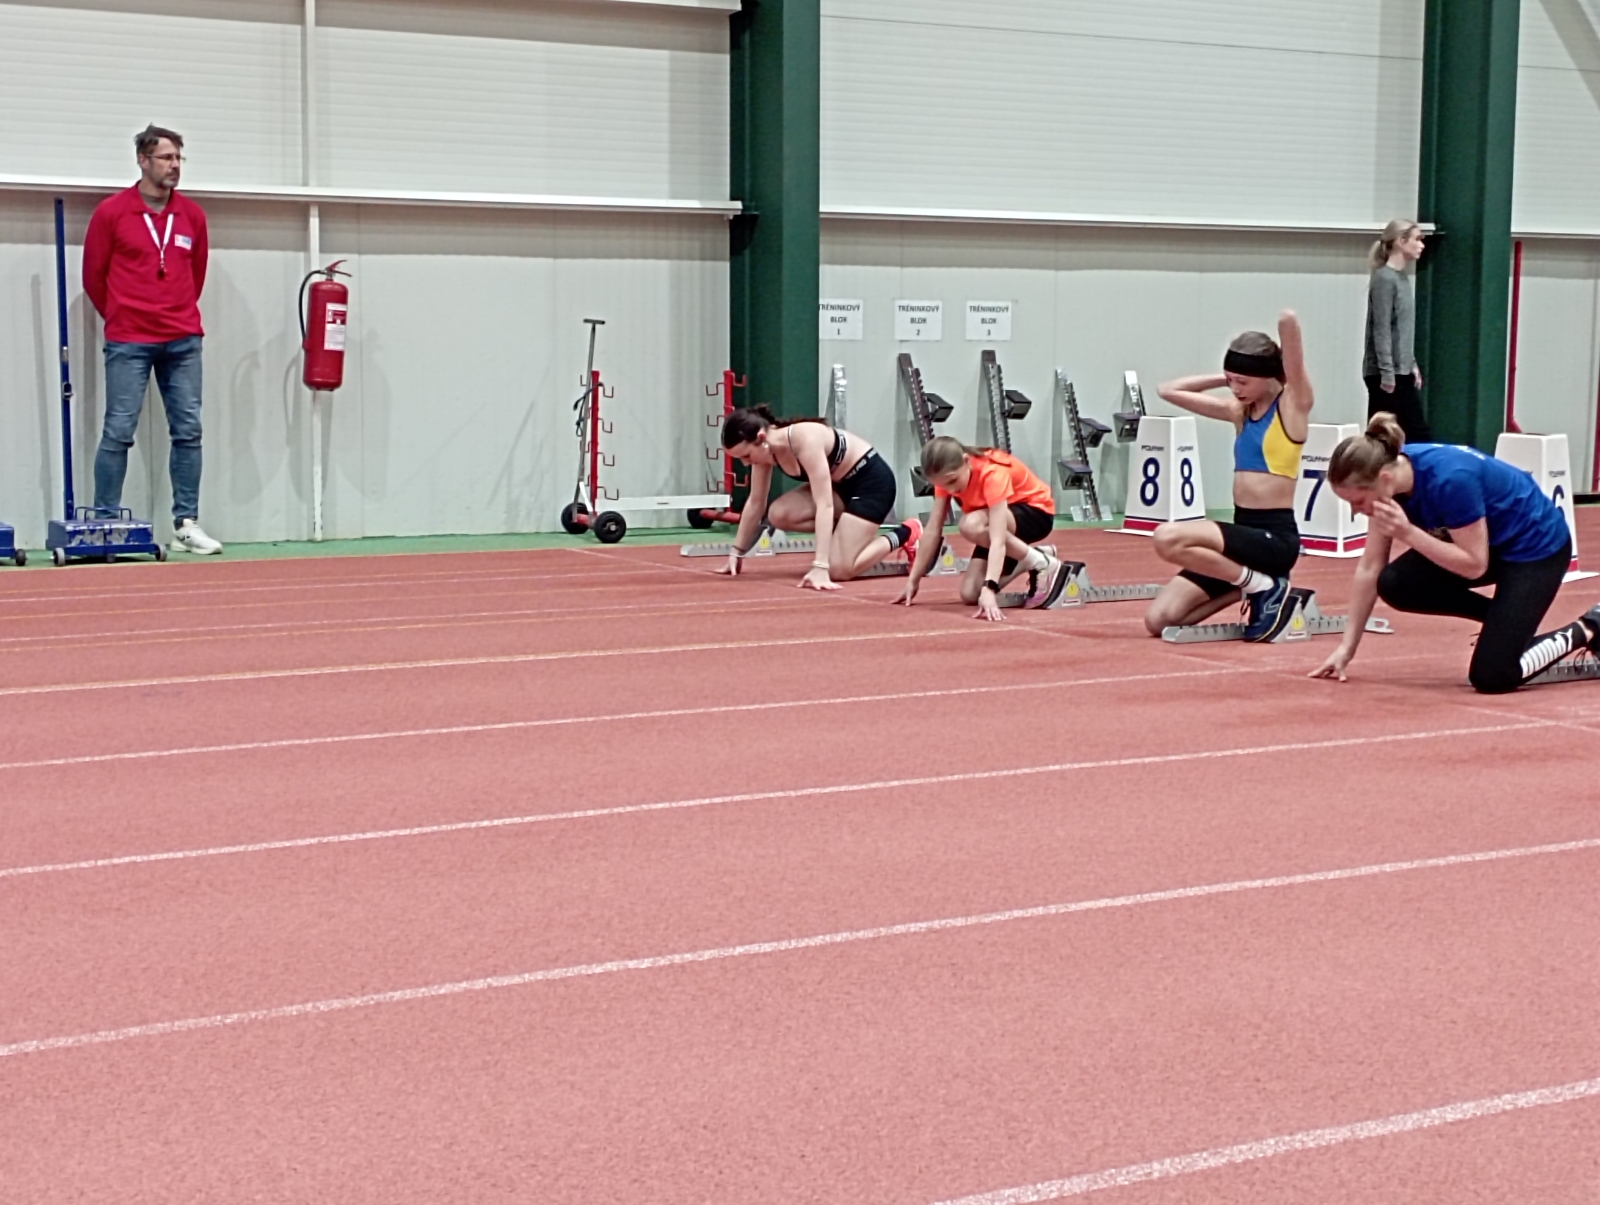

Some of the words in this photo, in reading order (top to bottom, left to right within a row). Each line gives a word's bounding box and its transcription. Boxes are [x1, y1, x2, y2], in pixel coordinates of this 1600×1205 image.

[898, 303, 940, 313] TRÉNINKOVÝ
[968, 303, 1010, 313] TRÉNINKOVÝ
[836, 328, 841, 336] 1
[915, 328, 921, 336] 2
[986, 328, 992, 336] 3
[1140, 457, 1160, 507] 8
[1180, 457, 1195, 507] 8
[1303, 469, 1328, 522] 7
